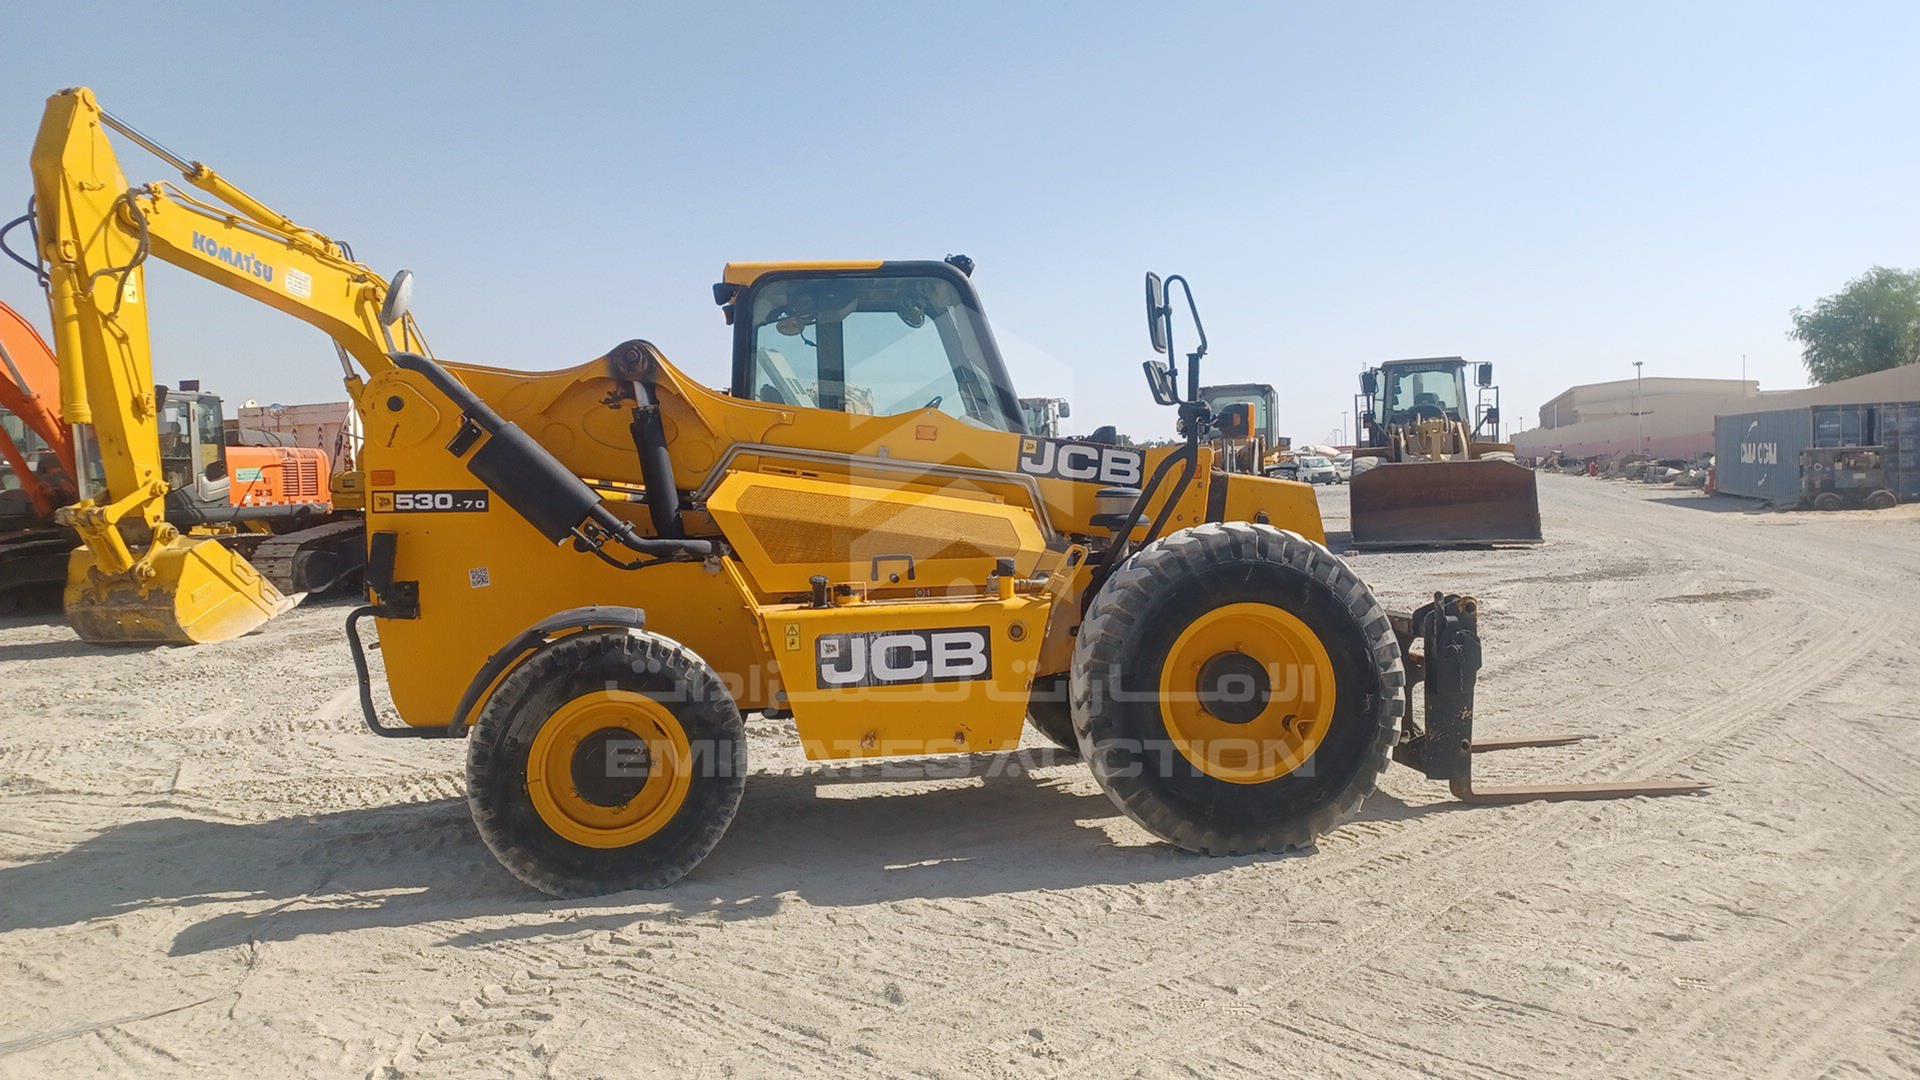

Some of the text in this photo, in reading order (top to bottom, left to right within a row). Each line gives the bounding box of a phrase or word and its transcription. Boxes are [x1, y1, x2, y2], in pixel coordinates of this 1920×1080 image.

[192, 231, 273, 283] KOMATSU
[1020, 441, 1142, 485] JCB
[820, 631, 988, 684] JCB
